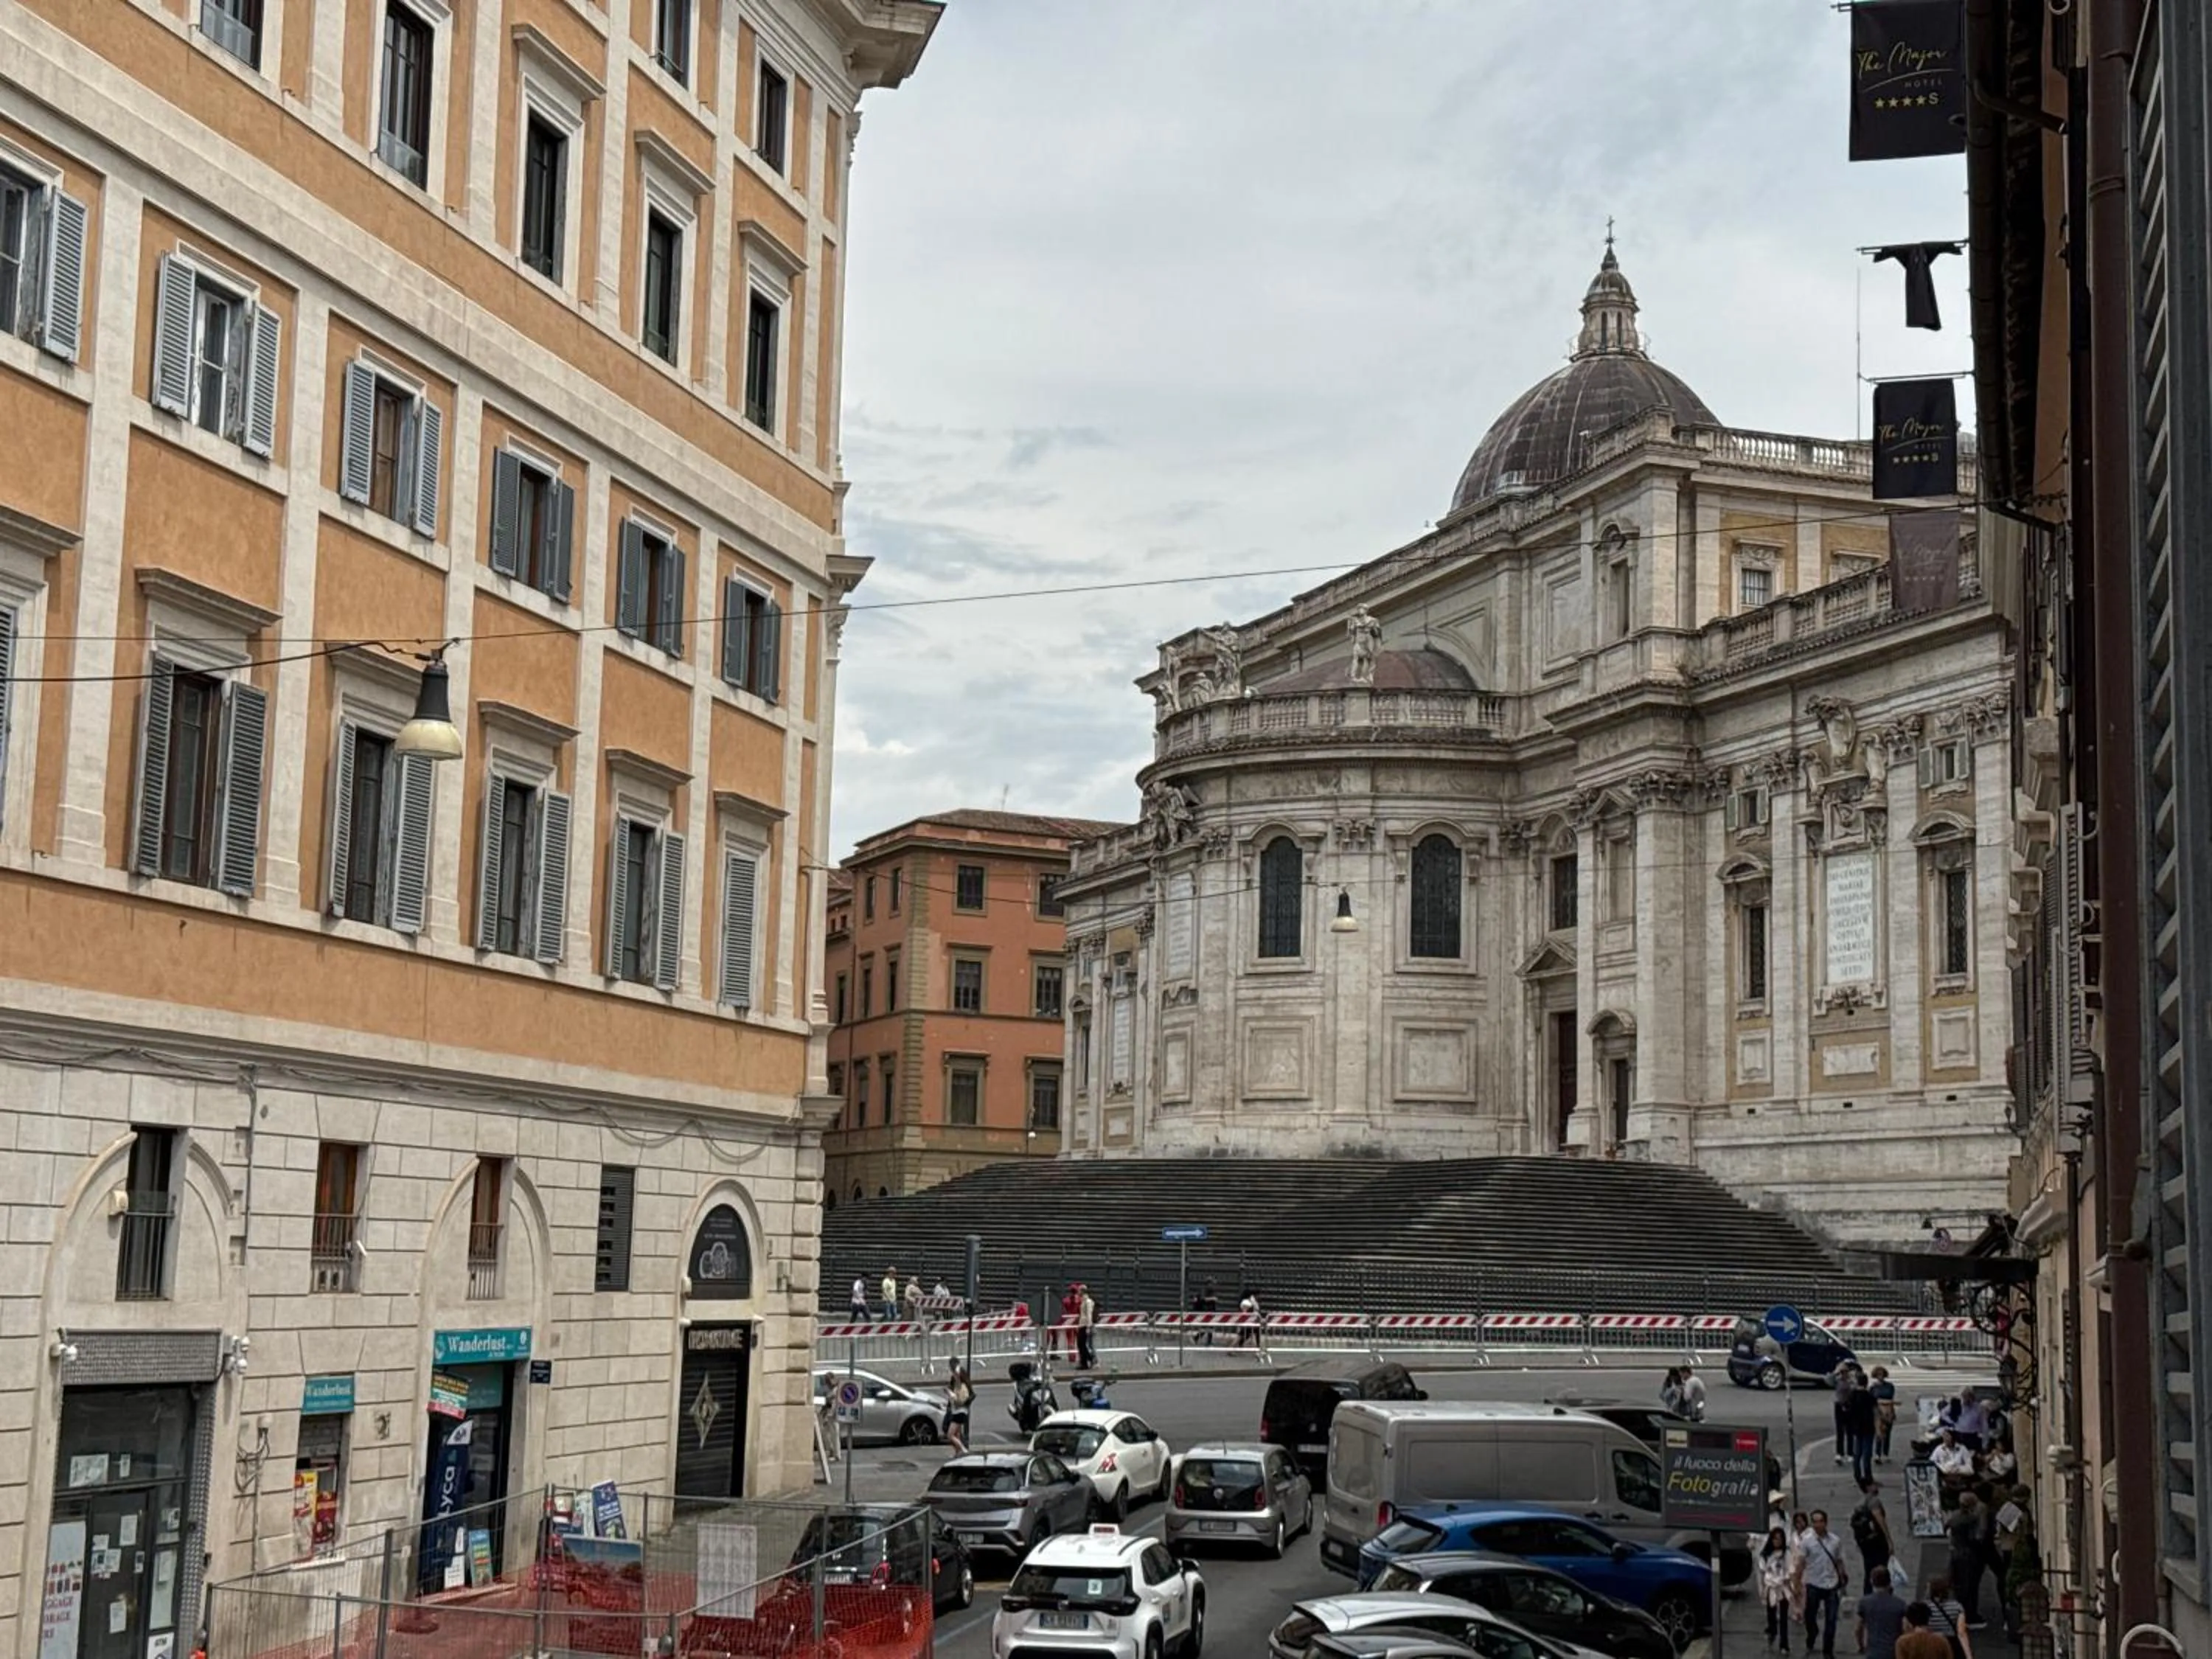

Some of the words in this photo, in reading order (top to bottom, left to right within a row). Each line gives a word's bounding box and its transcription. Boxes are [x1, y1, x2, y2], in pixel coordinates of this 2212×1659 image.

[1857, 49, 1884, 80] The
[1888, 41, 1947, 74] Major
[1904, 76, 1942, 88] HOTEL
[448, 1334, 506, 1353] Wanderlust
[1684, 1455, 1722, 1470] fuoco
[1723, 1458, 1757, 1472] della
[437, 1465, 456, 1517] Lyca
[1666, 1470, 1759, 1498] Fotografia
